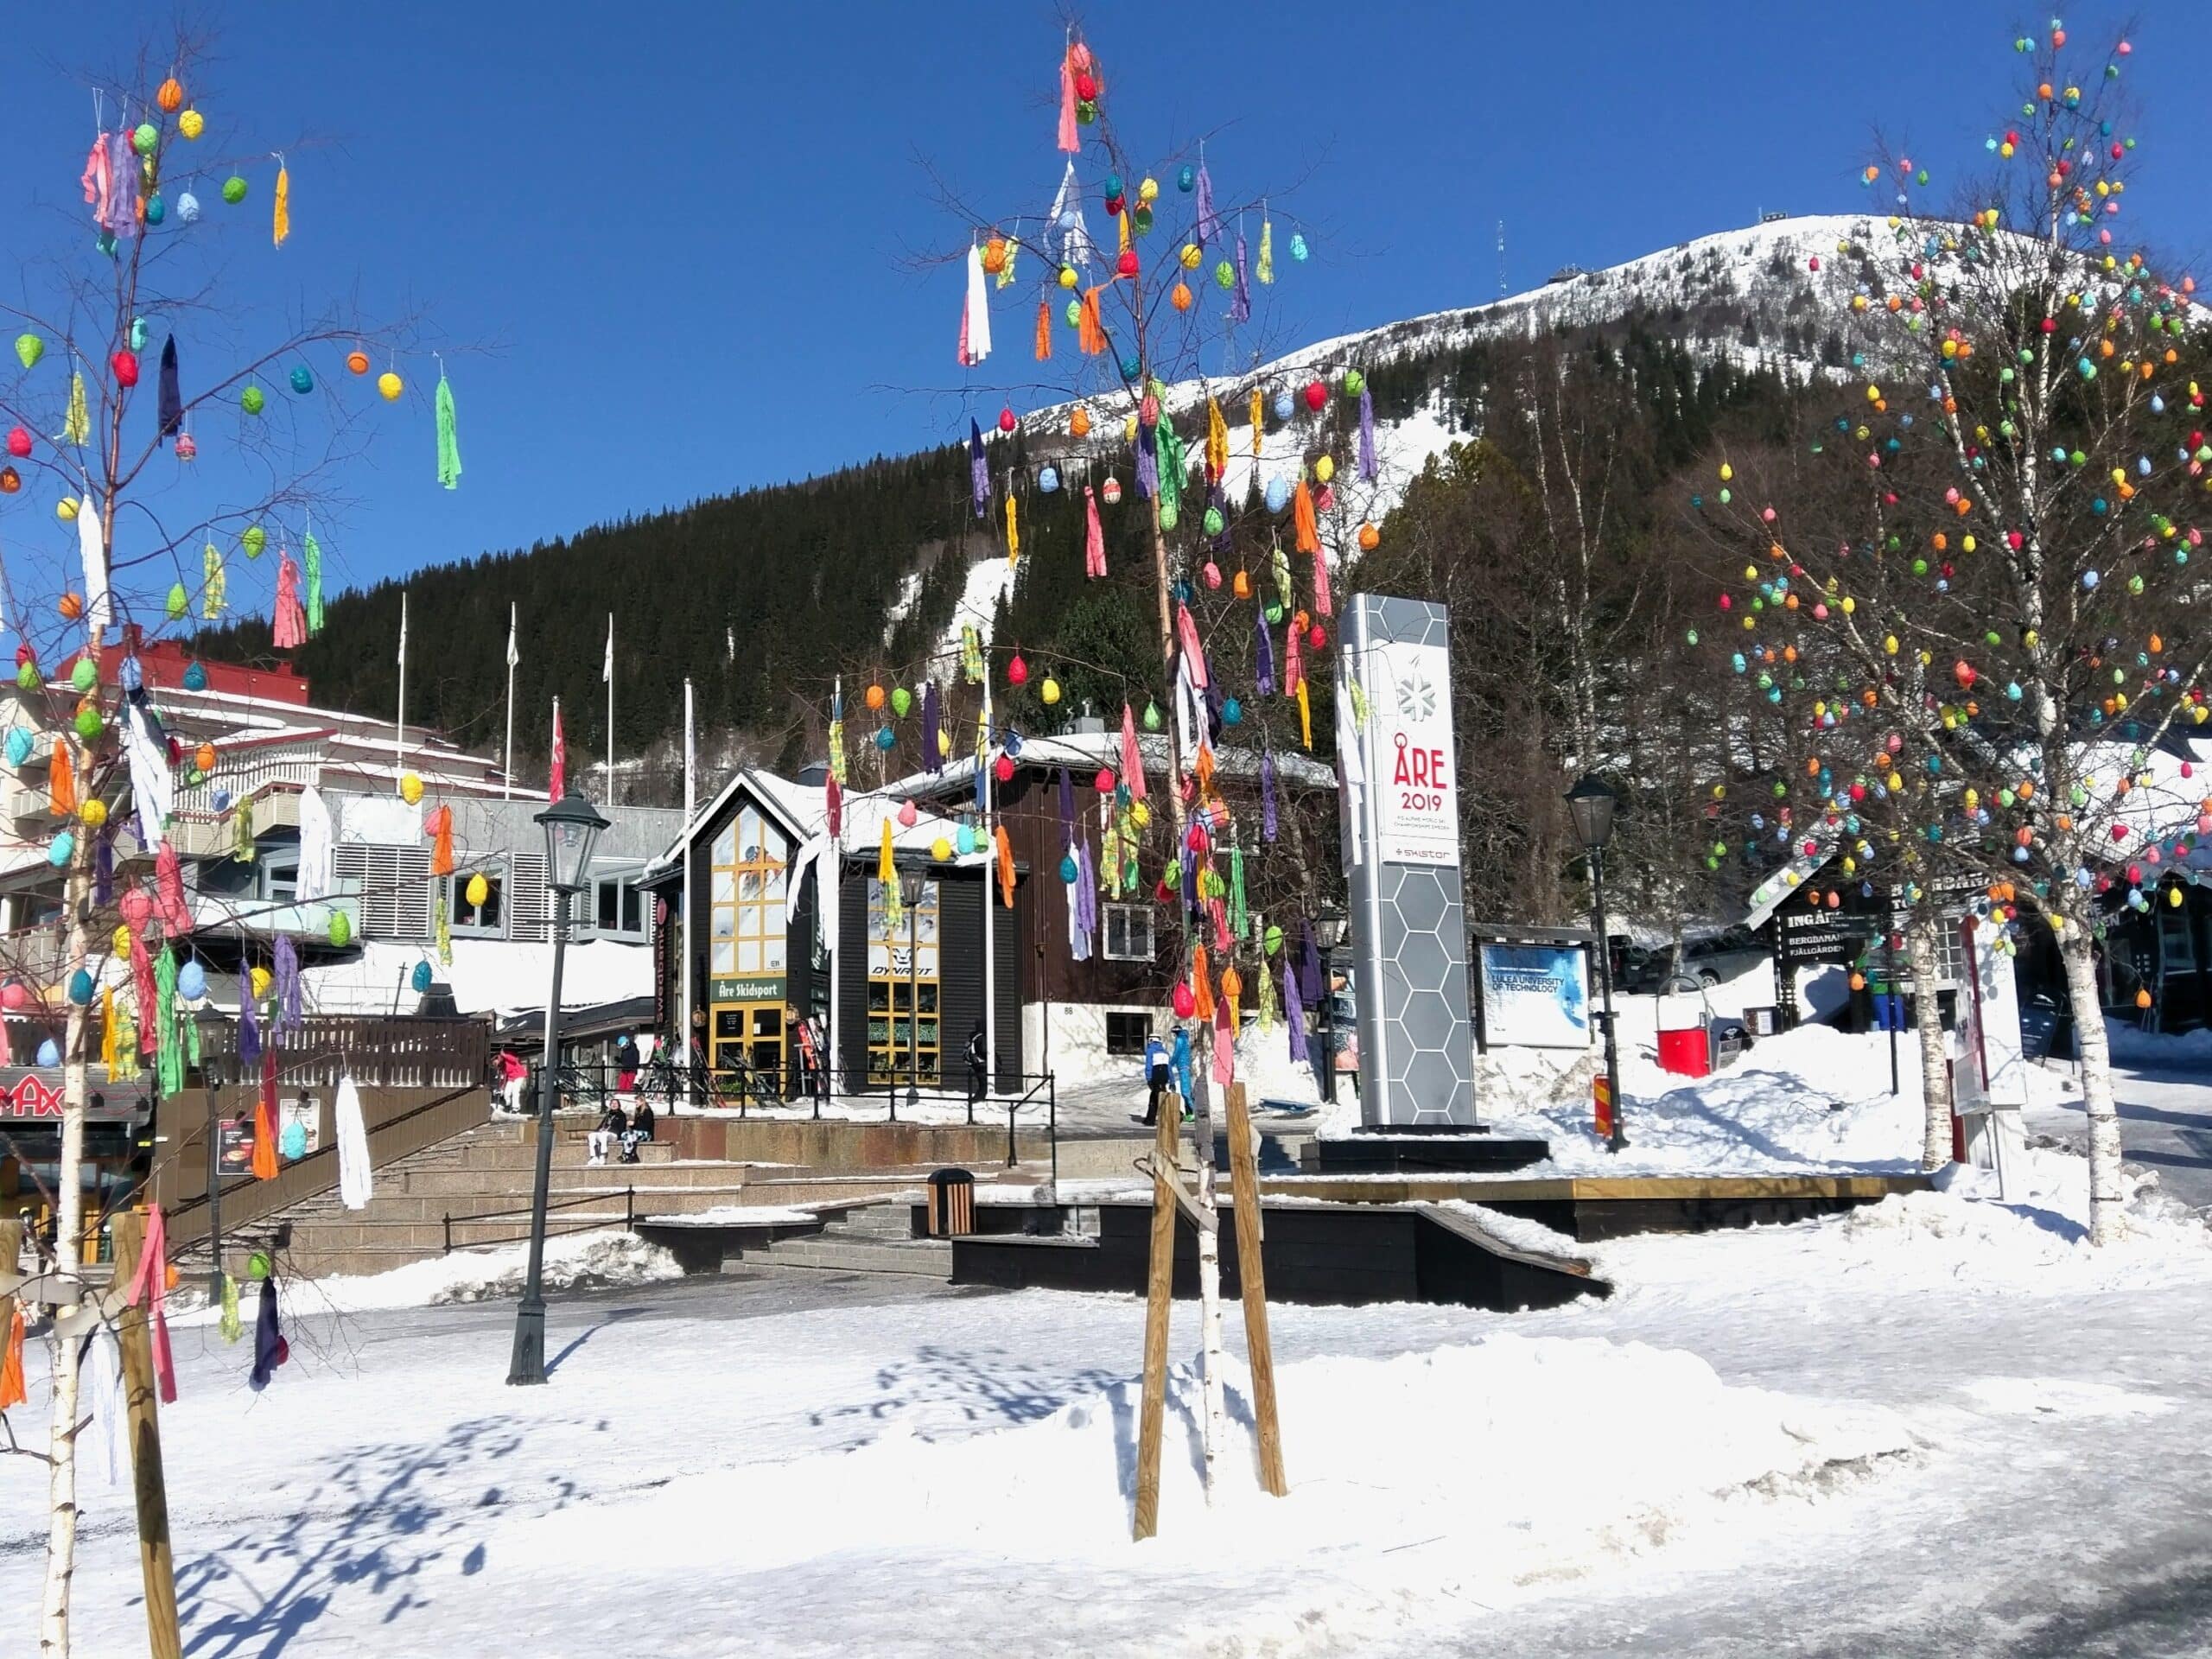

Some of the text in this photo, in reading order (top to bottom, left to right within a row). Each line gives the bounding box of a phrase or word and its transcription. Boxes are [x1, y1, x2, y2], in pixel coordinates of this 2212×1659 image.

[1394, 733, 1447, 789] ÅRE
[1401, 792, 1442, 811] 2019
[872, 966, 933, 976] DYNAIT
[1492, 982, 1558, 993] OF TECHNOLOGY
[1519, 976, 1565, 986] UNIVERSITY
[719, 981, 778, 999] Åre Skidsport
